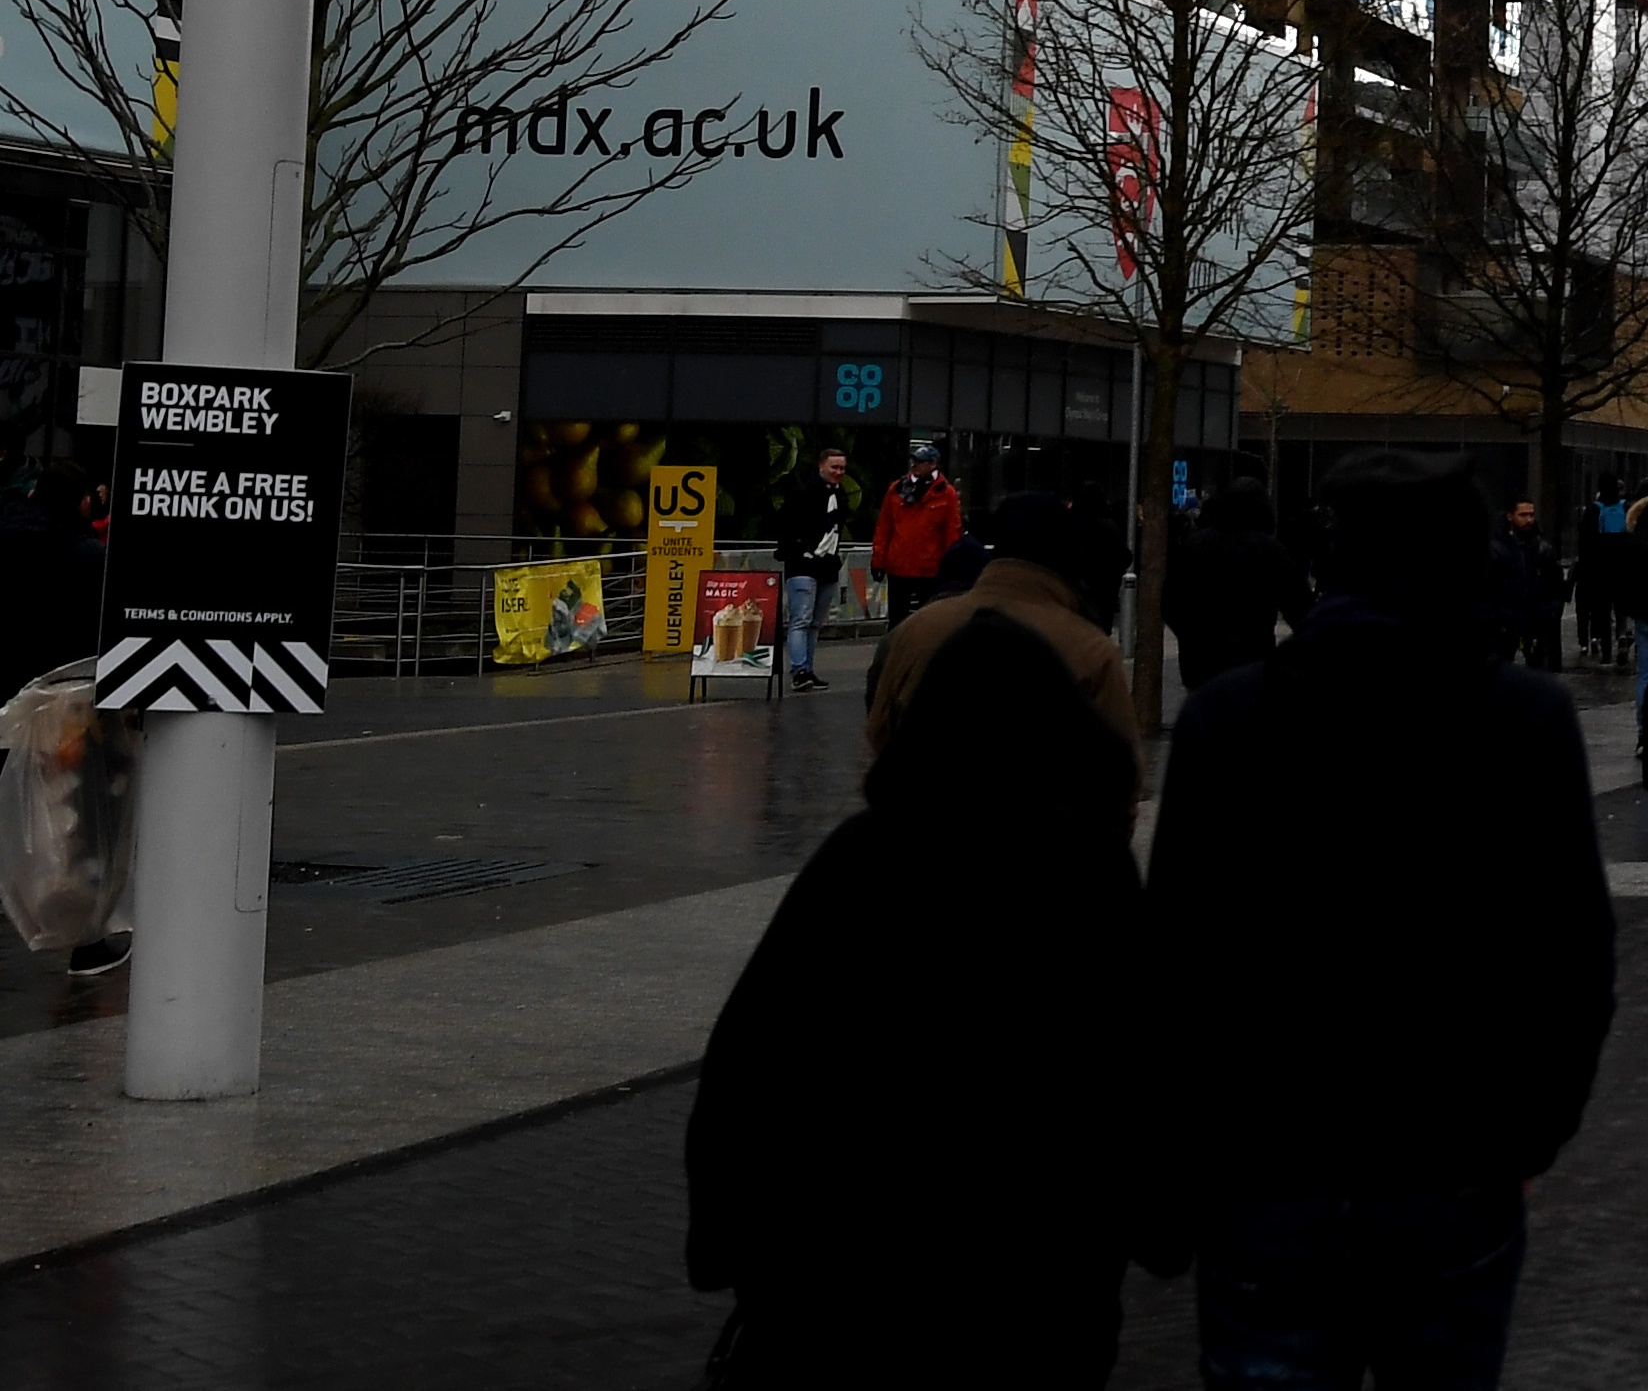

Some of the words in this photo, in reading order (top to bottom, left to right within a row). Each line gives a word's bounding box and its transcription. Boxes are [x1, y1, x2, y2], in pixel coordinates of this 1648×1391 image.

[456, 87, 845, 159] mdx.ac.uk
[141, 382, 272, 410] BOXPARK
[140, 406, 279, 435] WEMBLEY
[133, 468, 208, 493] HAVE
[212, 472, 230, 494] A
[237, 472, 308, 497] FREE
[131, 493, 220, 519] DRINK
[225, 497, 262, 520] ON
[270, 499, 314, 523] US!
[652, 546, 704, 557] STUDENTS
[663, 537, 693, 547] UNITE
[666, 560, 684, 647] WEMBLEY
[705, 589, 738, 597] MAGIC
[124, 608, 165, 621] TERMS
[168, 609, 178, 621] &
[180, 609, 253, 623] CONDITIONS
[254, 612, 294, 624] APPLY.
